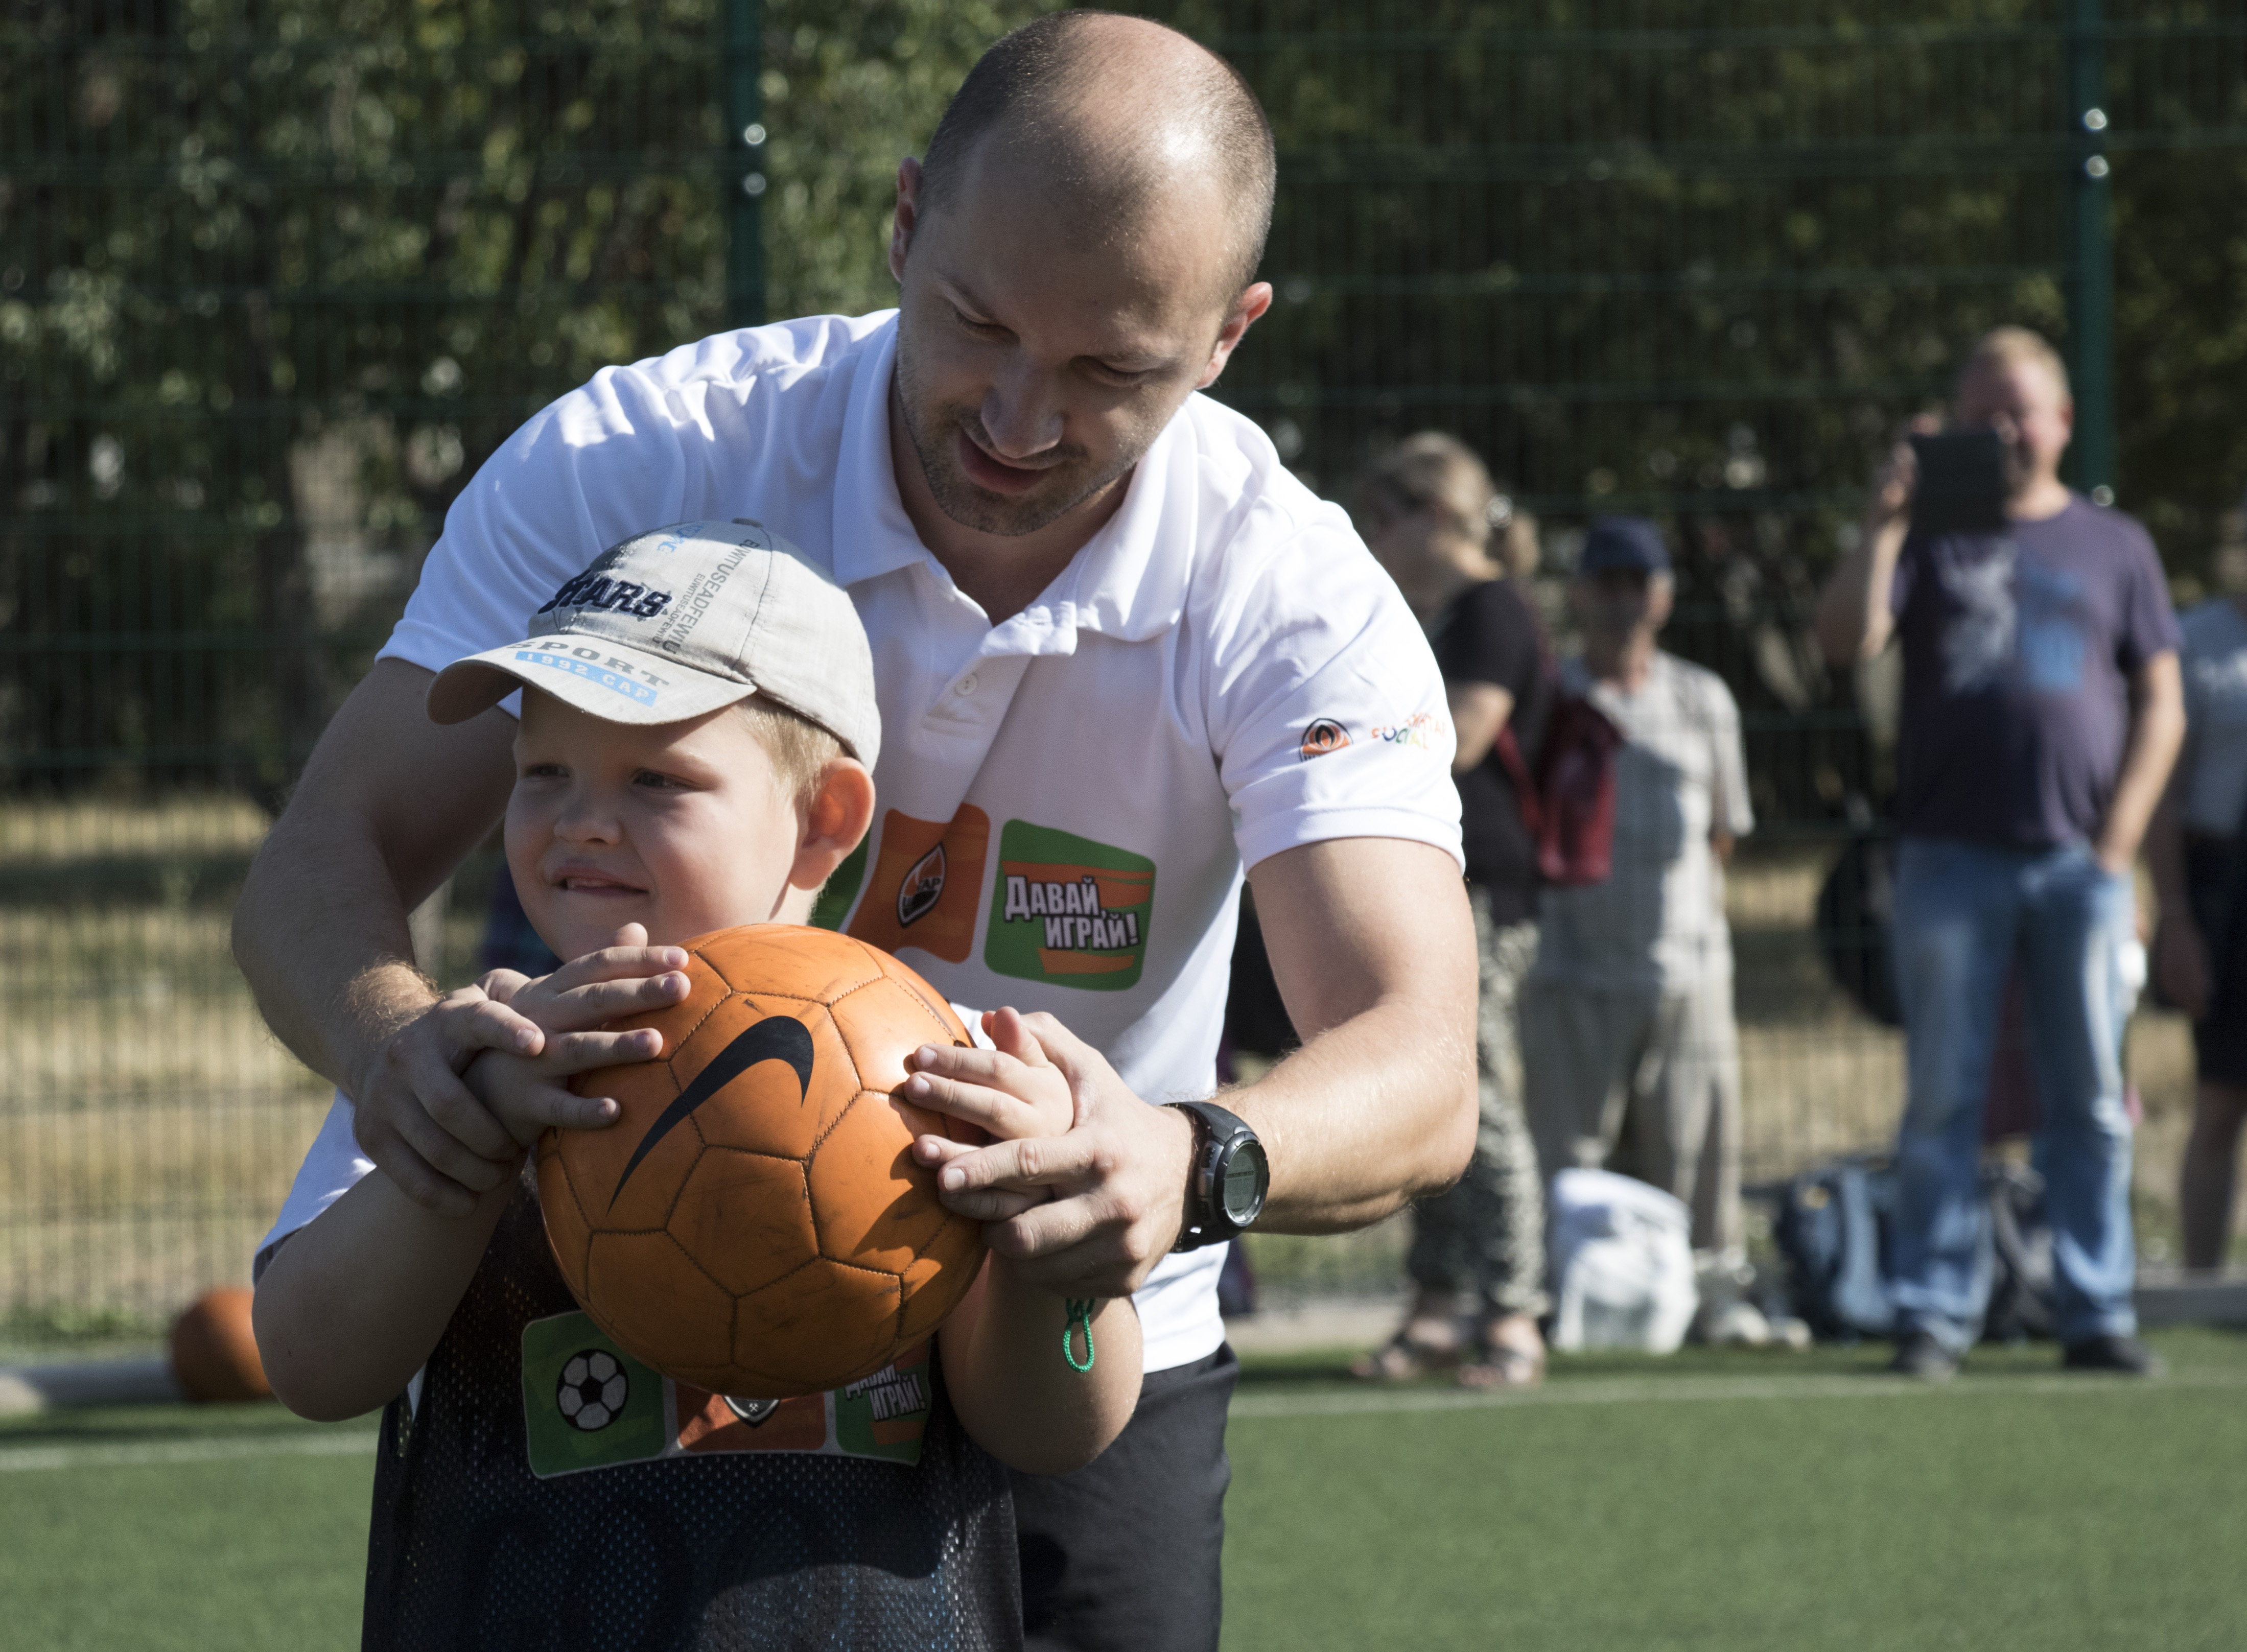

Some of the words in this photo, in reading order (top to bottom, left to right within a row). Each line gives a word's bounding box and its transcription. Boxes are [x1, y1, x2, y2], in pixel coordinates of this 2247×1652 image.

[506, 641, 670, 686] SPORT
[526, 653, 649, 698] 1992.CAP
[1044, 912, 1139, 950] ИГРАЙ!
[869, 1373, 927, 1421] ИГРАЙ!
